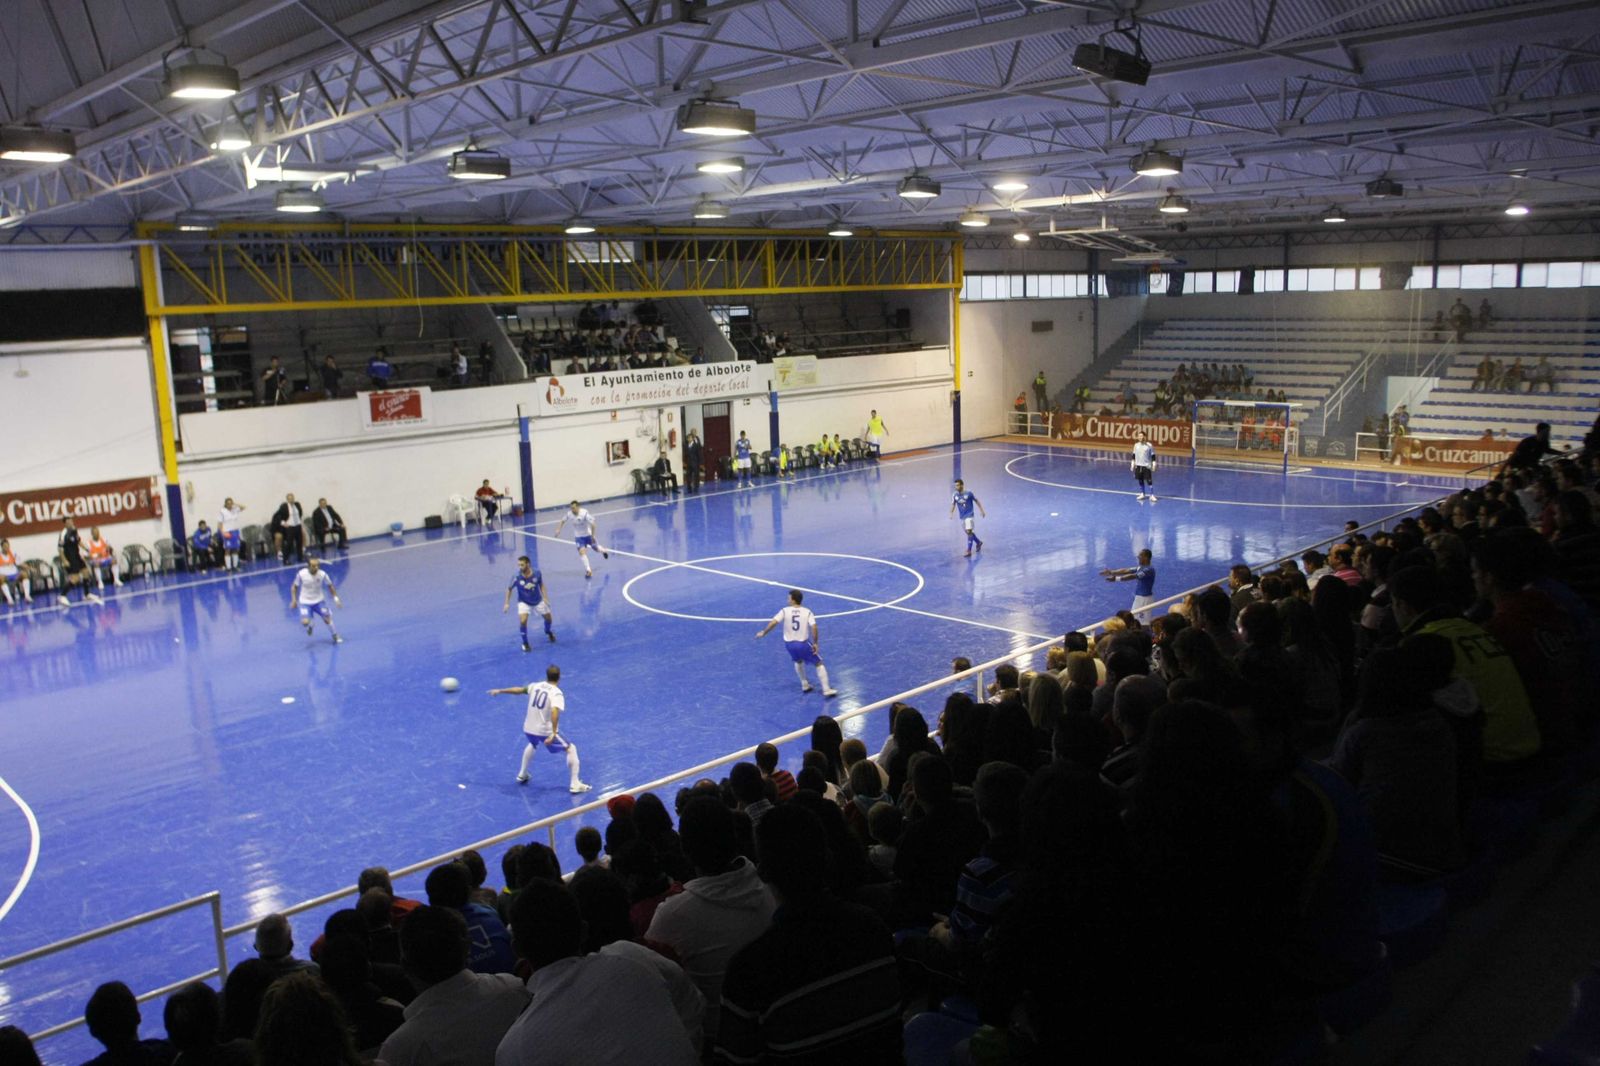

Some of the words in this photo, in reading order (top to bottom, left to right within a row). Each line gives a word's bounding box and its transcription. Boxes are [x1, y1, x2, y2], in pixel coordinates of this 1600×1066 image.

[584, 376, 595, 387] El
[601, 371, 684, 388] Ayuntamiento
[688, 369, 701, 379] de
[706, 363, 751, 377] Albolote
[591, 396, 606, 405] con
[611, 390, 620, 404] la
[676, 382, 690, 396] del
[693, 379, 725, 397] deporte
[729, 377, 750, 391] local
[1086, 416, 1181, 445] Cruzcampo
[7, 491, 137, 525] Cruzcampo
[792, 614, 800, 631] 5
[532, 688, 548, 710] 10
